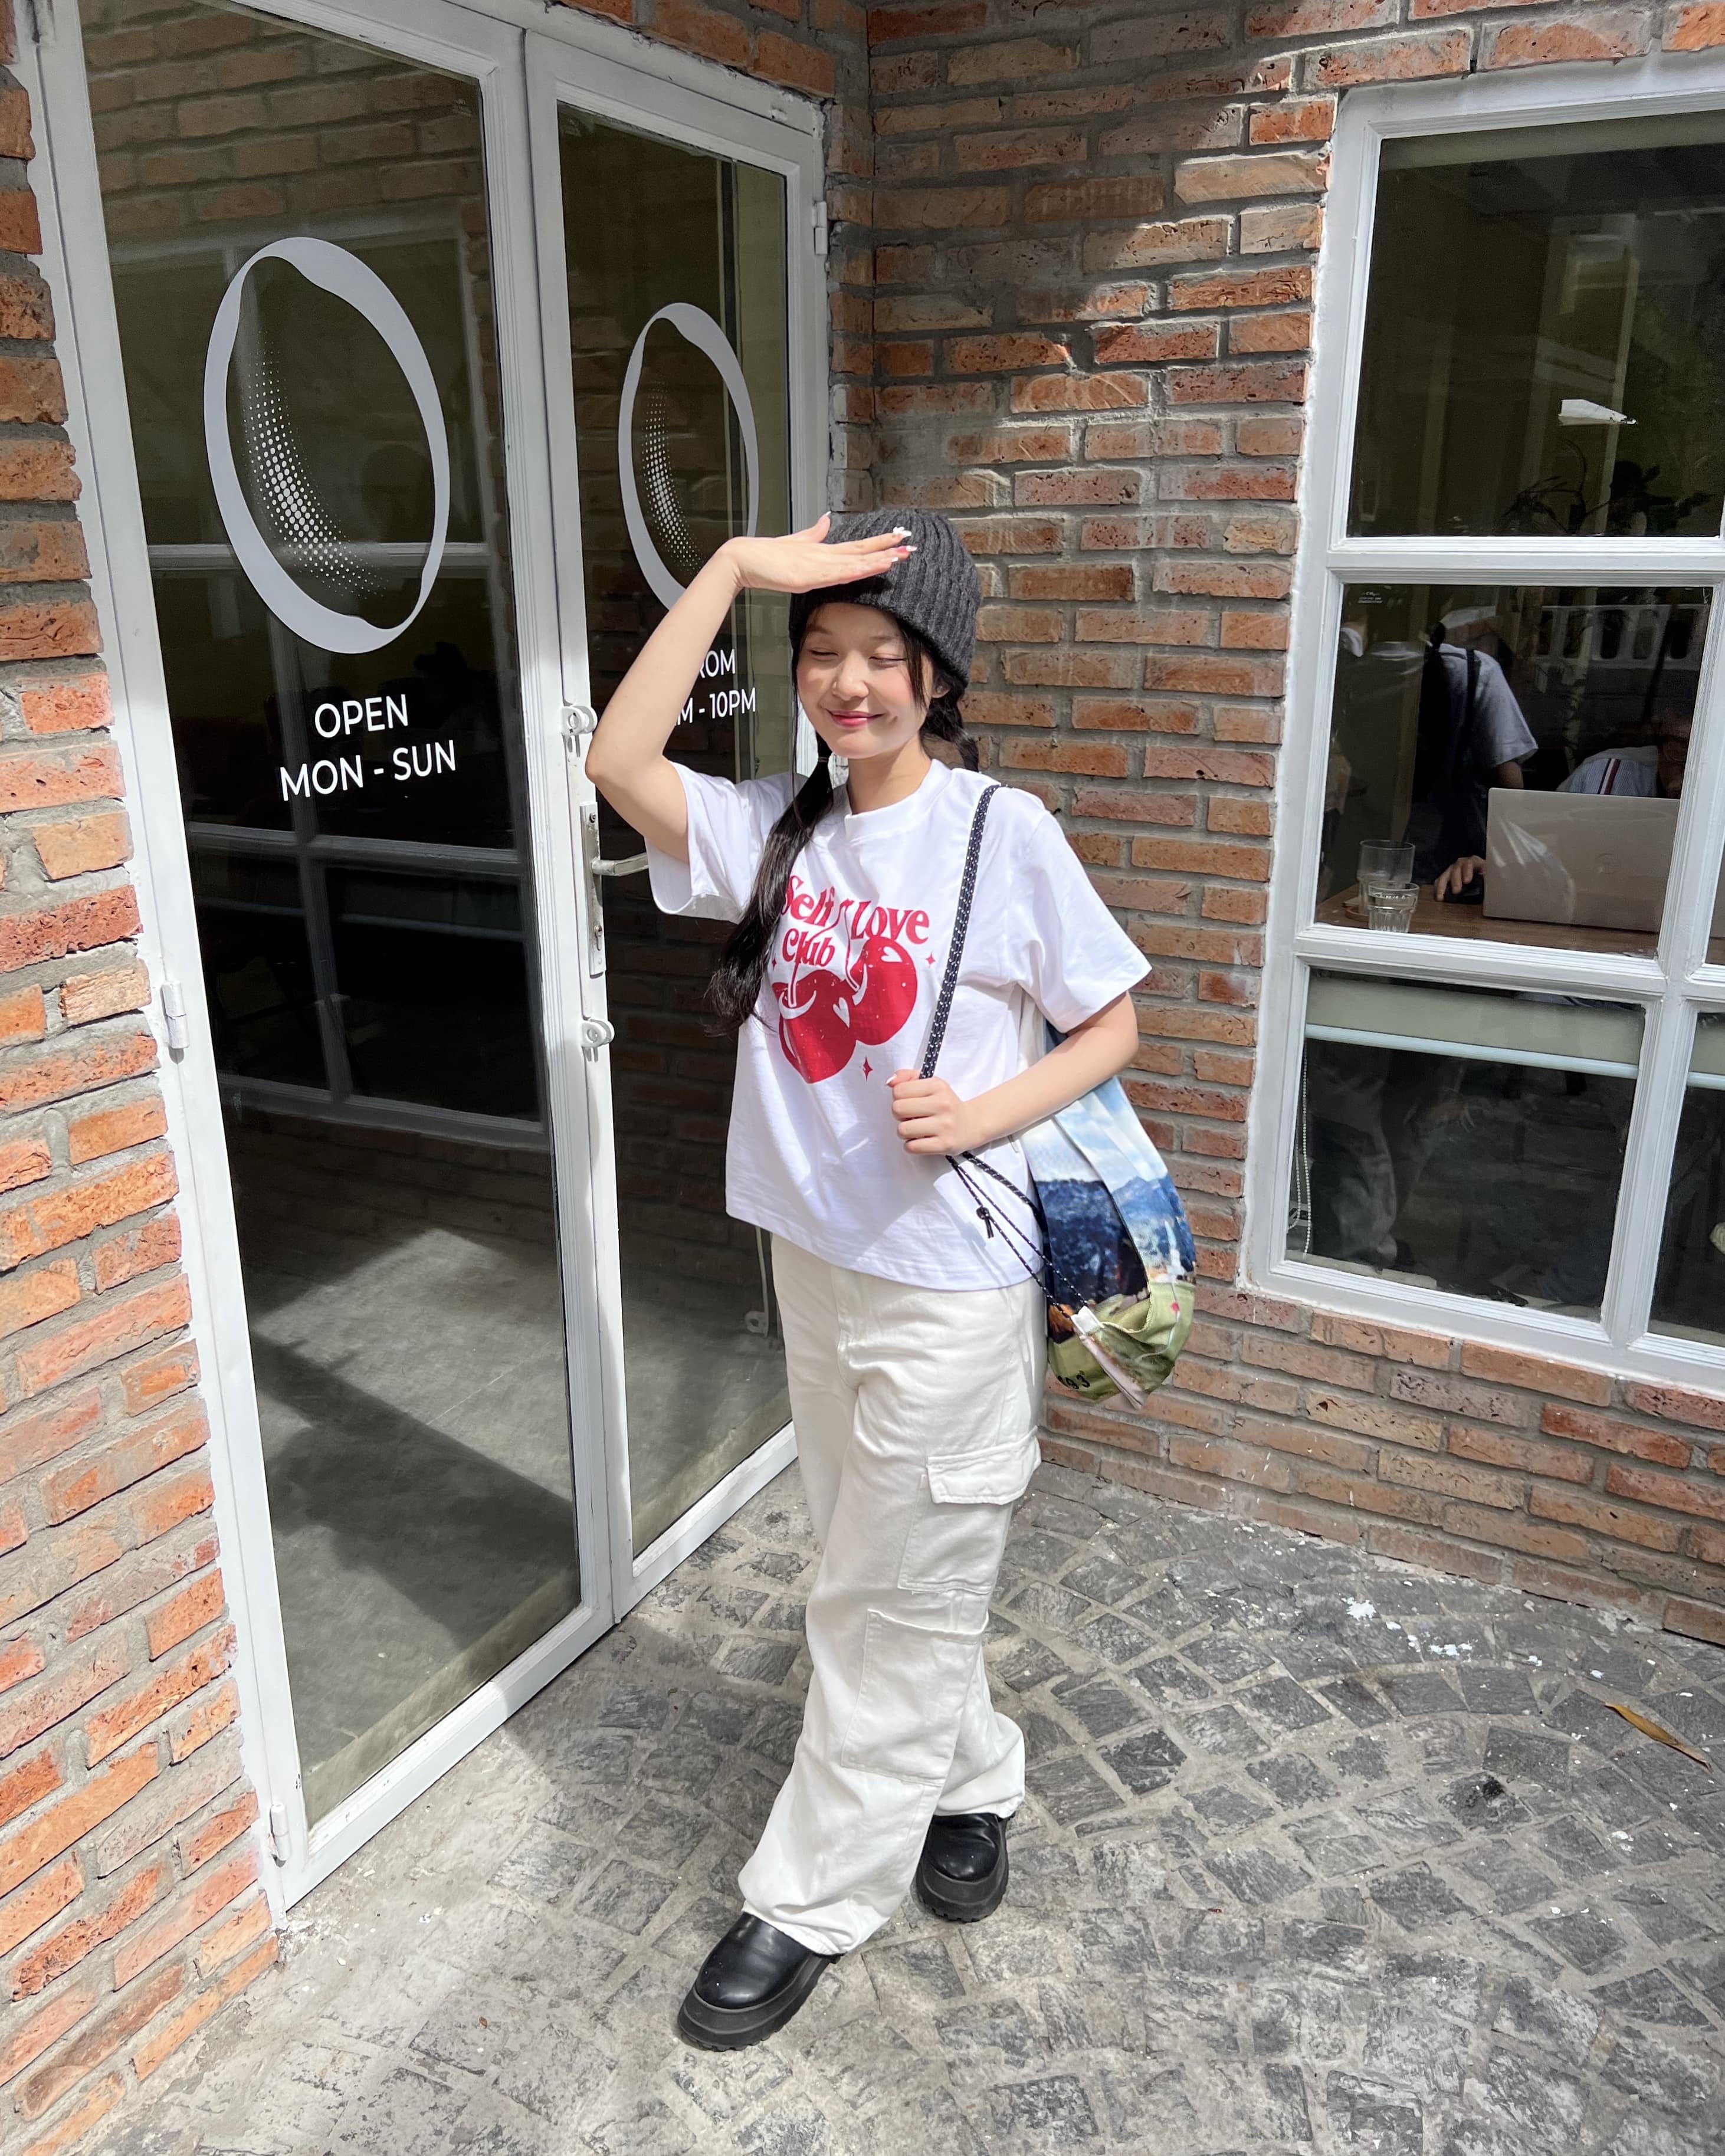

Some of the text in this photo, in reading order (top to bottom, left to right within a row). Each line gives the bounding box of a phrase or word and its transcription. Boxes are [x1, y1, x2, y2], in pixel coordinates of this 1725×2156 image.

[314, 694, 408, 738] OPEN
[709, 687, 756, 718] 10PM
[280, 754, 364, 801] MON
[393, 740, 455, 781] SUN
[781, 875, 929, 944] Self Love
[782, 928, 835, 967] Club
